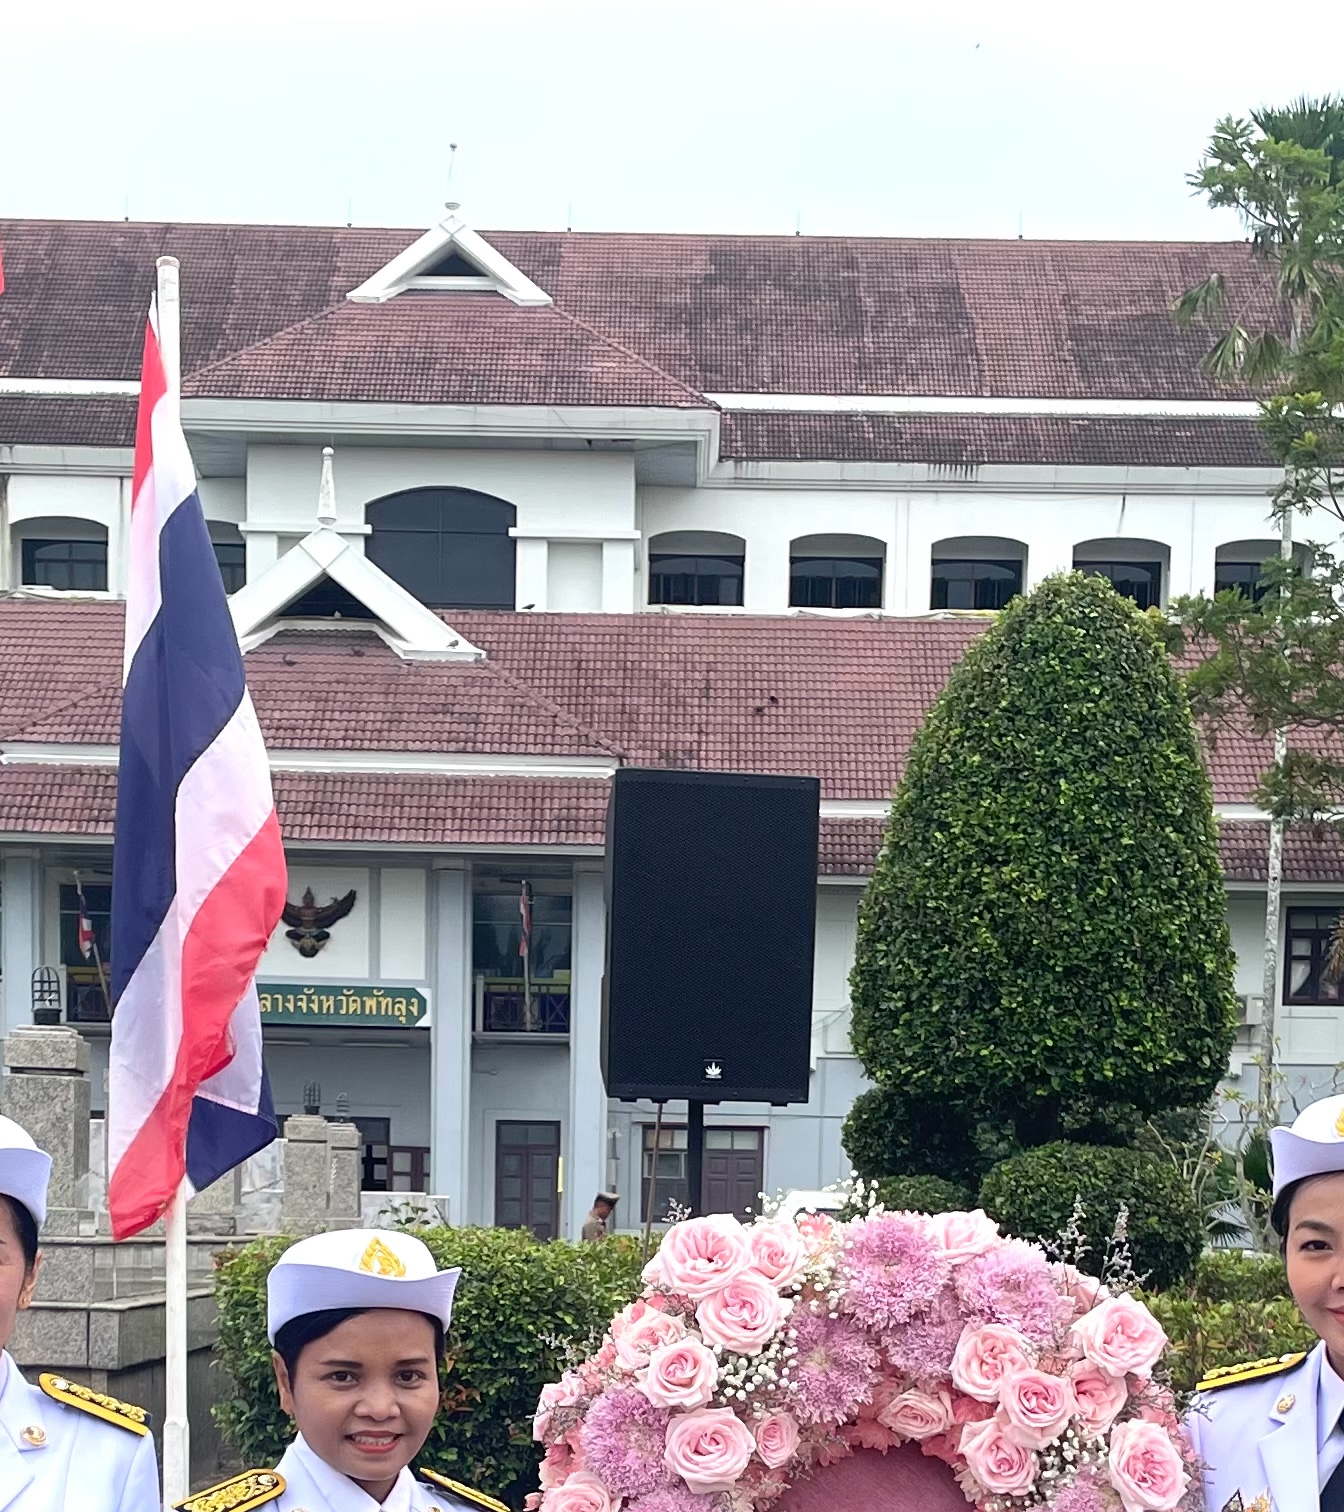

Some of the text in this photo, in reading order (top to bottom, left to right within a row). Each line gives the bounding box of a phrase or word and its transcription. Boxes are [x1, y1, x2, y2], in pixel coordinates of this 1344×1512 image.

[259, 986, 419, 1025] ลางจังหวัดพัทลุง
